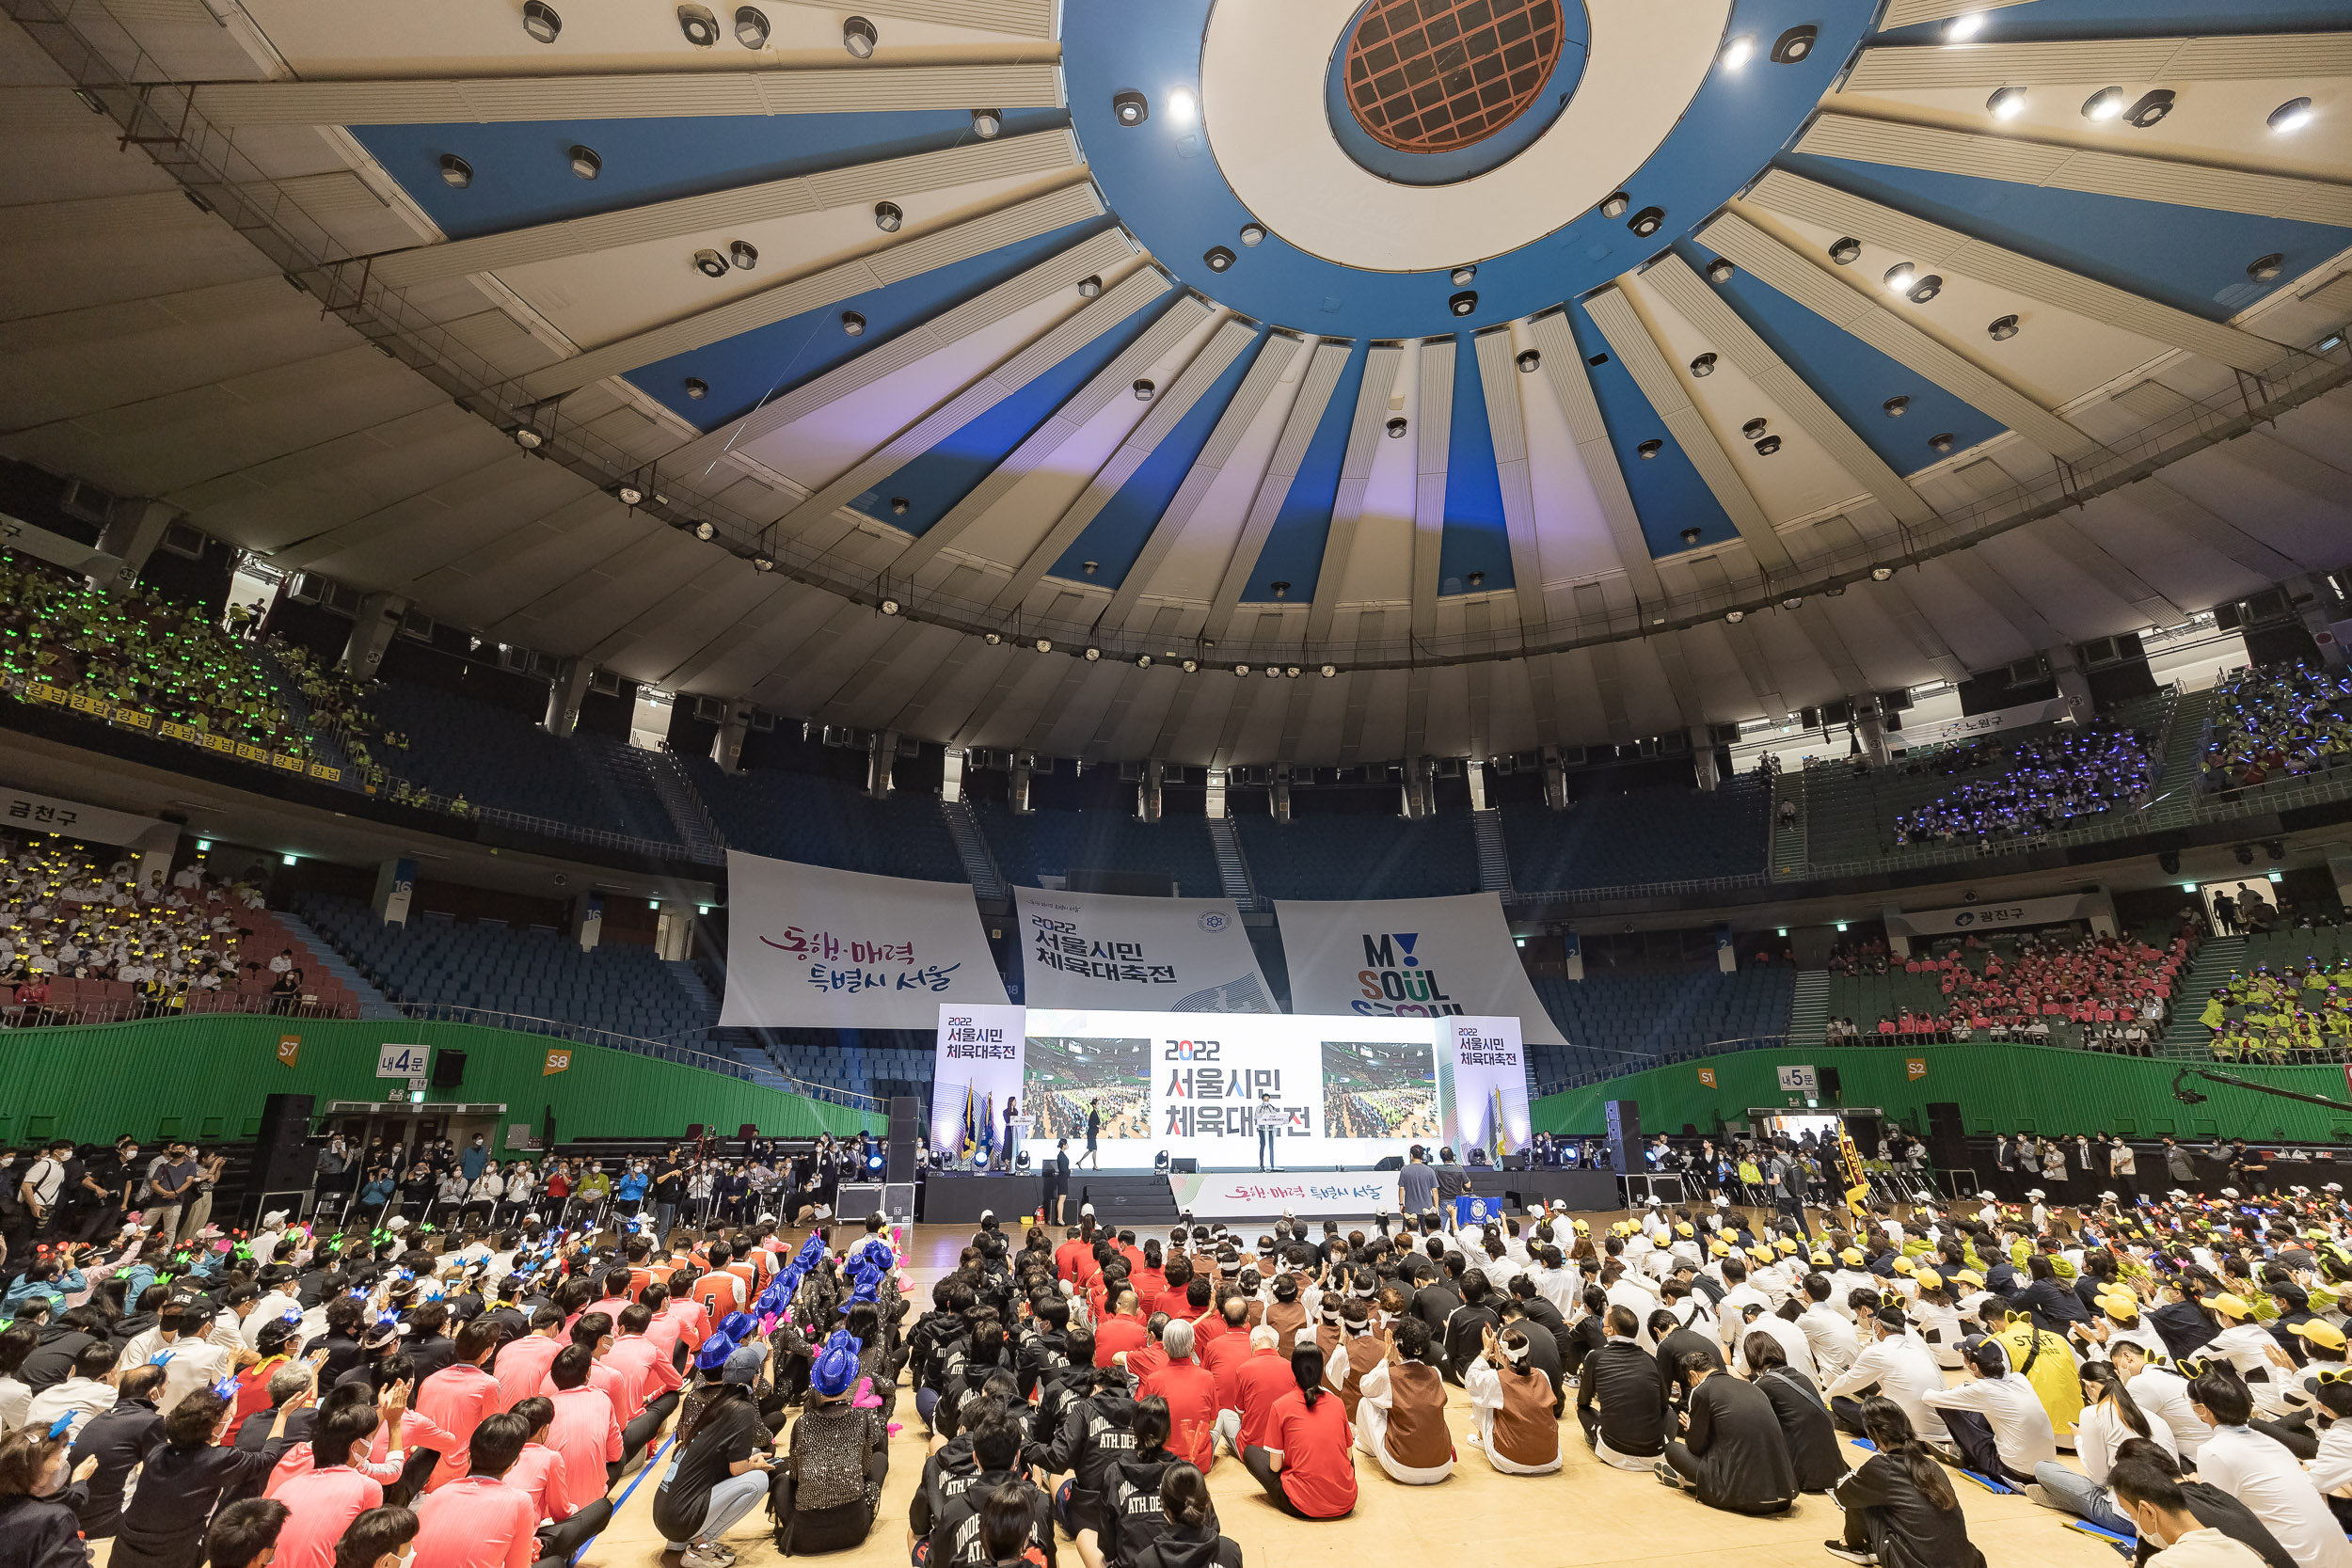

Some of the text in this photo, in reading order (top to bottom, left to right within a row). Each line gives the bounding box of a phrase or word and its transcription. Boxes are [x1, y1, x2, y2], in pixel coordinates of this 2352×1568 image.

[0, 520, 23, 538] 구
[1965, 716, 2003, 731] 노원구
[9, 800, 77, 826] 금천구
[394, 880, 412, 893] 16
[587, 910, 601, 920] 16
[1979, 908, 2025, 923] 광진구
[1031, 913, 1077, 935] 2022
[1035, 929, 1144, 962] 서울시민
[1037, 946, 1178, 984] 체육대축전
[807, 962, 961, 993] 특별시 서울
[947, 1017, 973, 1026] 2022
[947, 1027, 1003, 1043] 서울시민
[1458, 1027, 1478, 1037] 2022
[278, 1041, 298, 1057] S7
[946, 1044, 1016, 1060] 체육대축전
[1165, 1039, 1220, 1062] 2022
[1460, 1037, 1505, 1051] 서울시민
[382, 1049, 423, 1072] 내4문
[547, 1054, 568, 1069] S8
[1460, 1052, 1518, 1066] 체육대축전
[1908, 1063, 1926, 1074] S2
[1166, 1068, 1281, 1100] 서울시민
[1701, 1072, 1713, 1083] S1
[1781, 1069, 1814, 1086] 내5문
[1165, 1104, 1311, 1138] 체육대전
[1310, 1185, 1349, 1201] 특별시
[1353, 1184, 1383, 1200] 서울
[173, 1293, 193, 1305] 마포
[704, 1292, 716, 1318] 5
[2013, 1334, 2055, 1347] STFF
[1099, 1433, 1120, 1449] ATH.
[1128, 1497, 1149, 1514] ATH.
